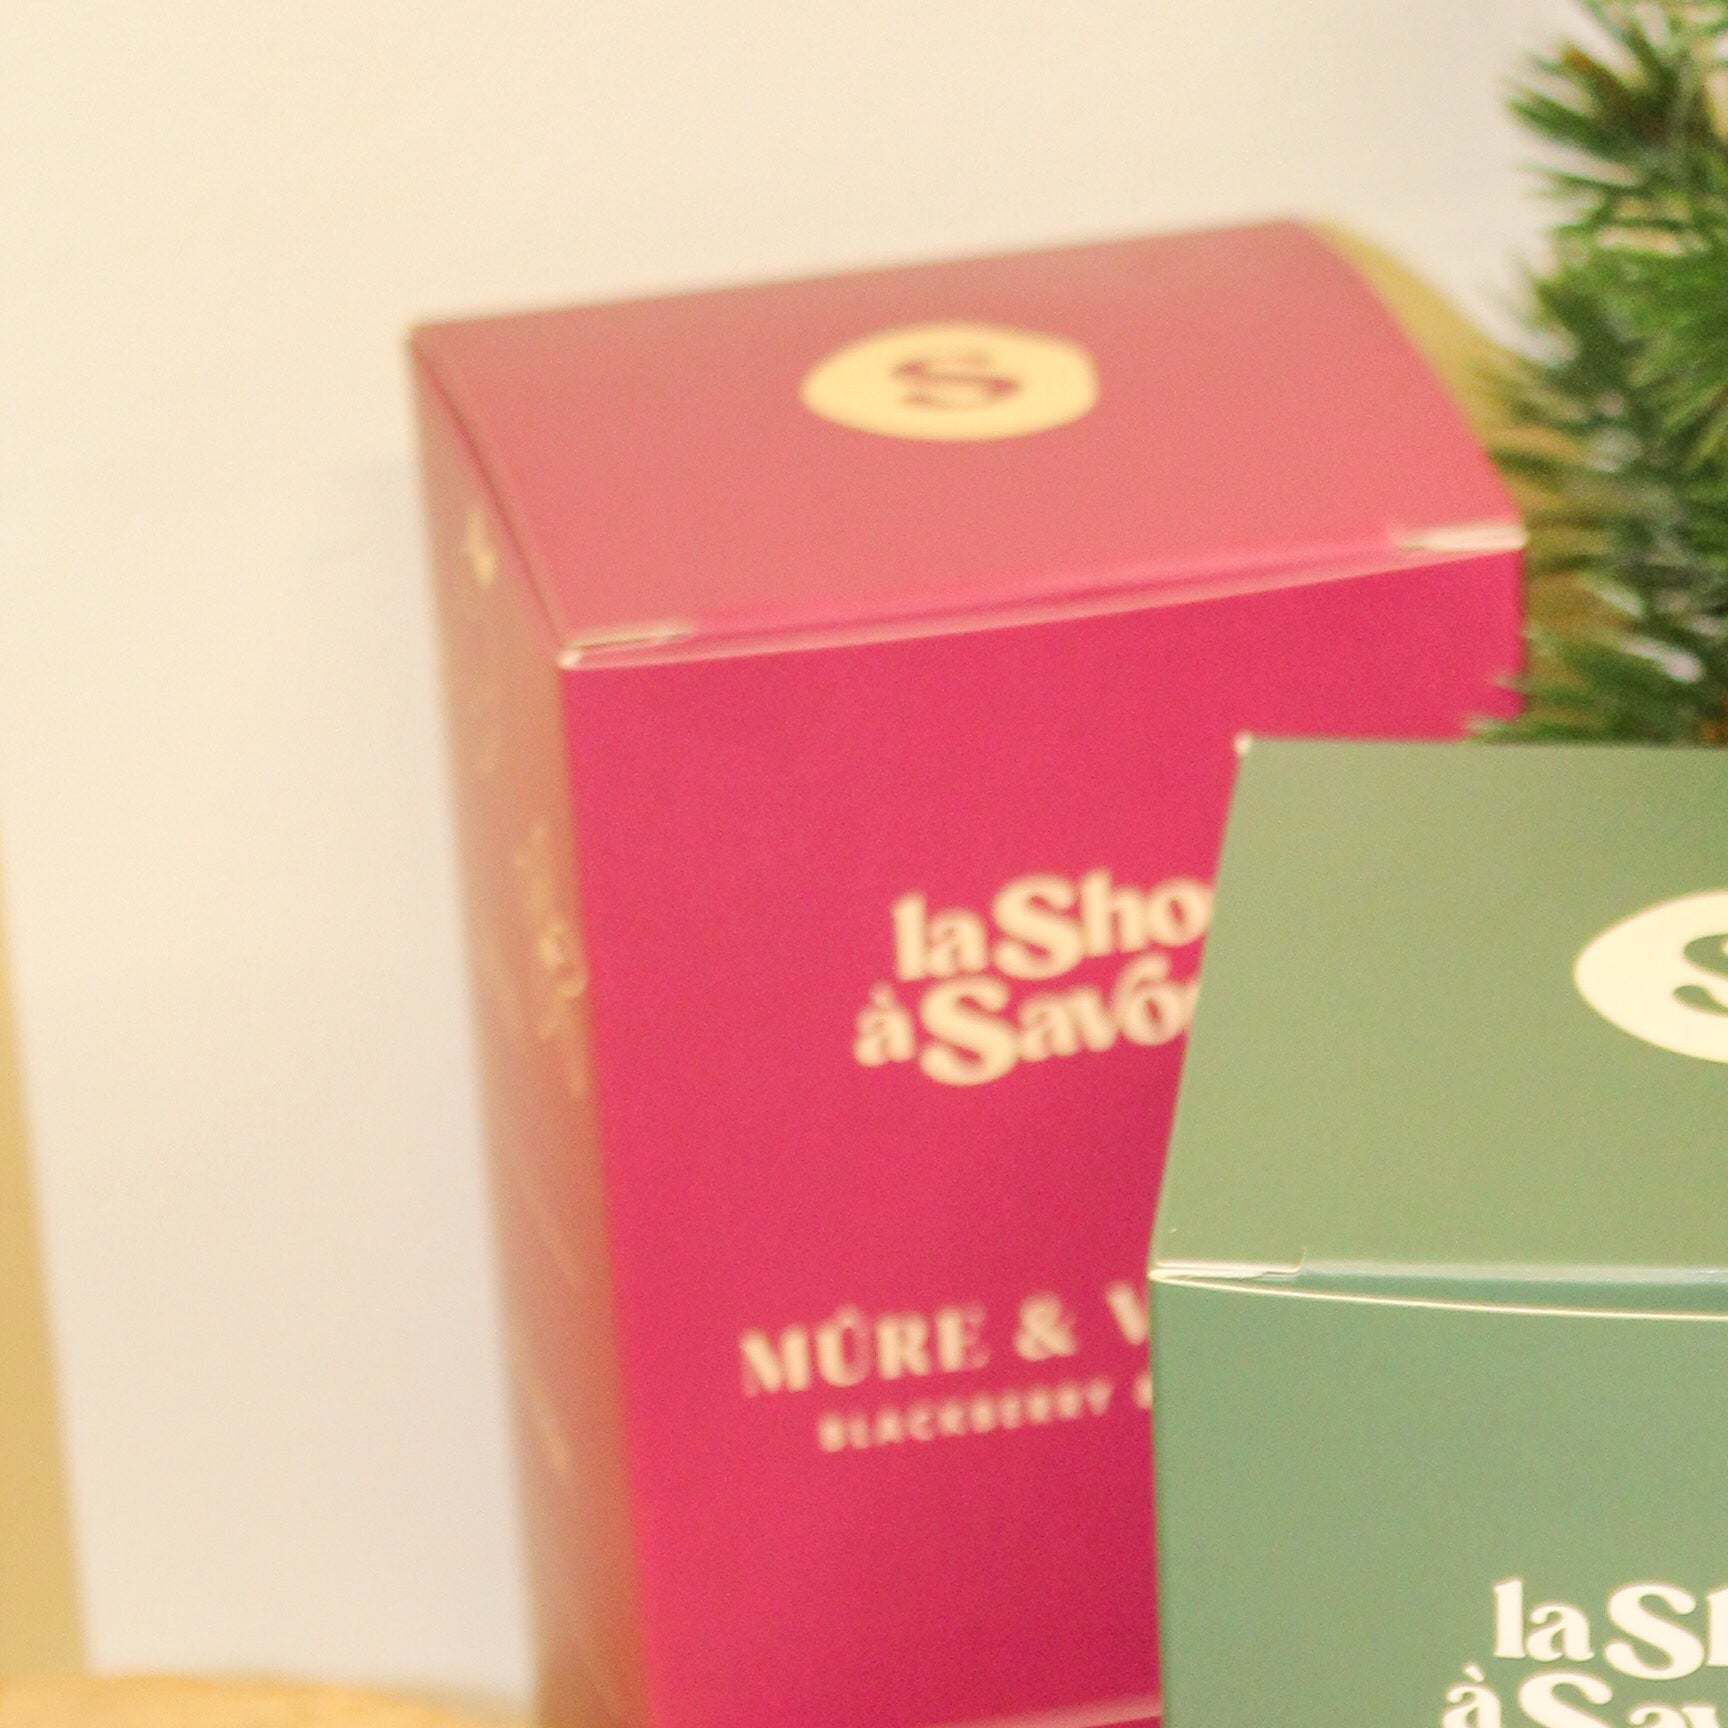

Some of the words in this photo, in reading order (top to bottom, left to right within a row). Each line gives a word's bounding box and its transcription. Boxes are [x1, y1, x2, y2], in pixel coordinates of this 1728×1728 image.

[887, 349, 1026, 411] S
[892, 892, 988, 982] la
[991, 871, 1213, 980] Sho
[854, 981, 916, 1067] à
[919, 954, 1199, 1086] Savo
[740, 1304, 990, 1397] MÛRE
[1013, 1293, 1077, 1361] &
[817, 1376, 1113, 1452] BLACKBERRY
[1493, 1579, 1595, 1662] la
